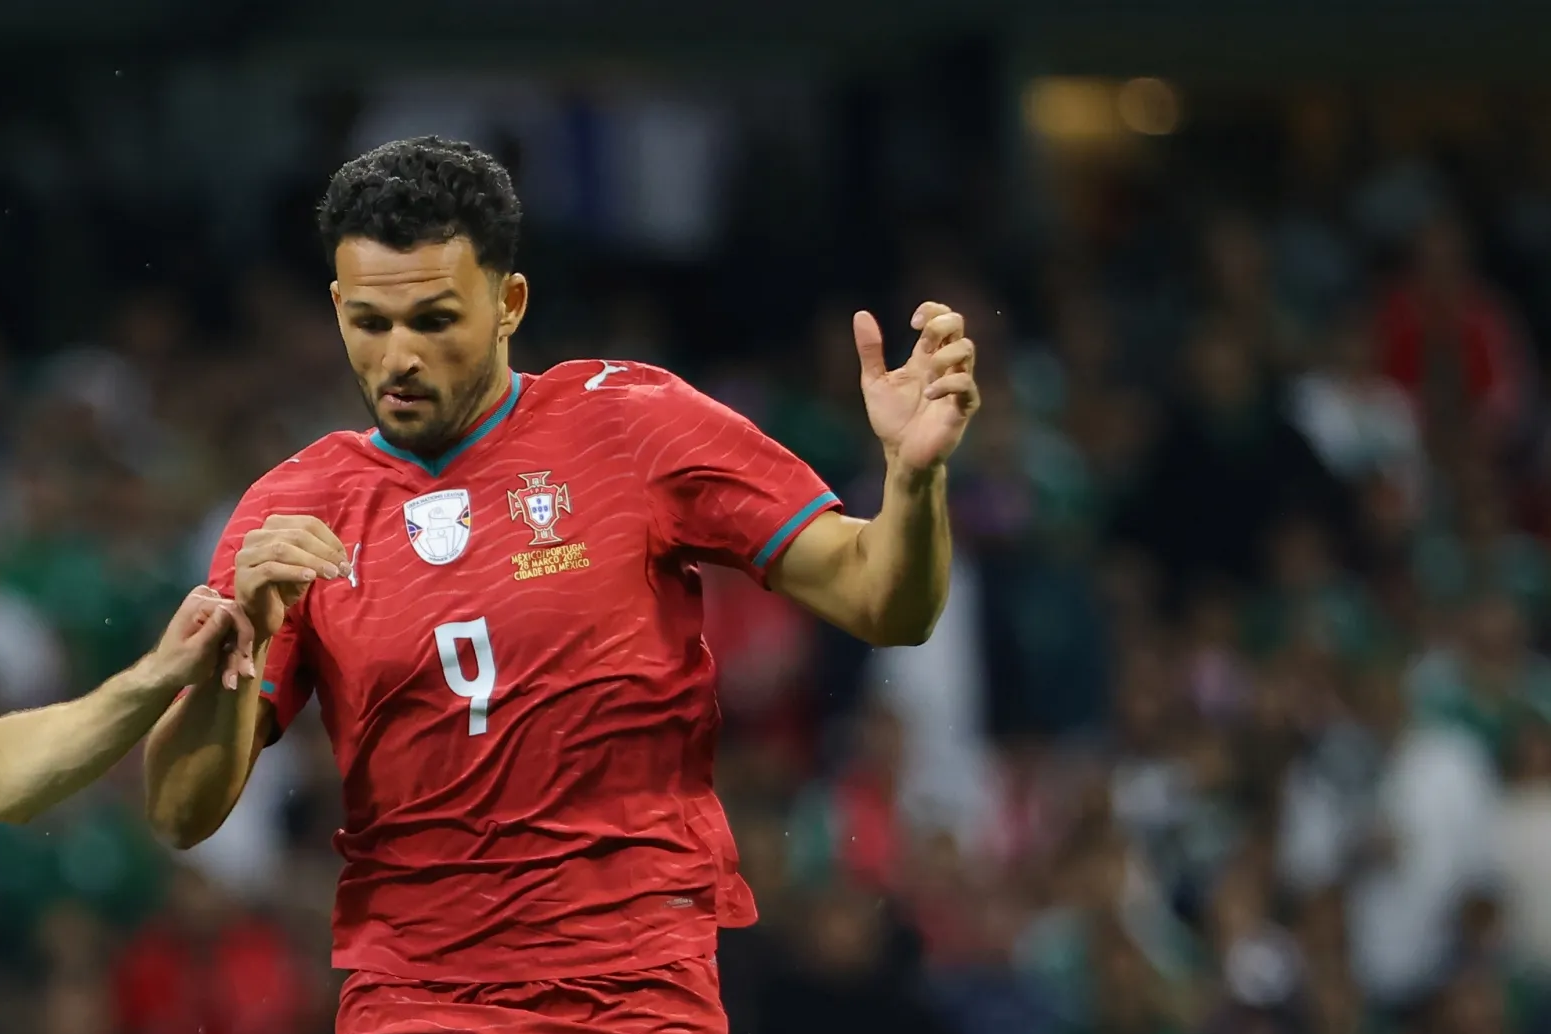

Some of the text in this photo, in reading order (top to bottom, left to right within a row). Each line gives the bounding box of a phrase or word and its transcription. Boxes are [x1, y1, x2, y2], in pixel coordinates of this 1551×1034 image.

[514, 567, 543, 581] CIDADE
[544, 564, 557, 575] DO
[434, 616, 496, 736] 9
